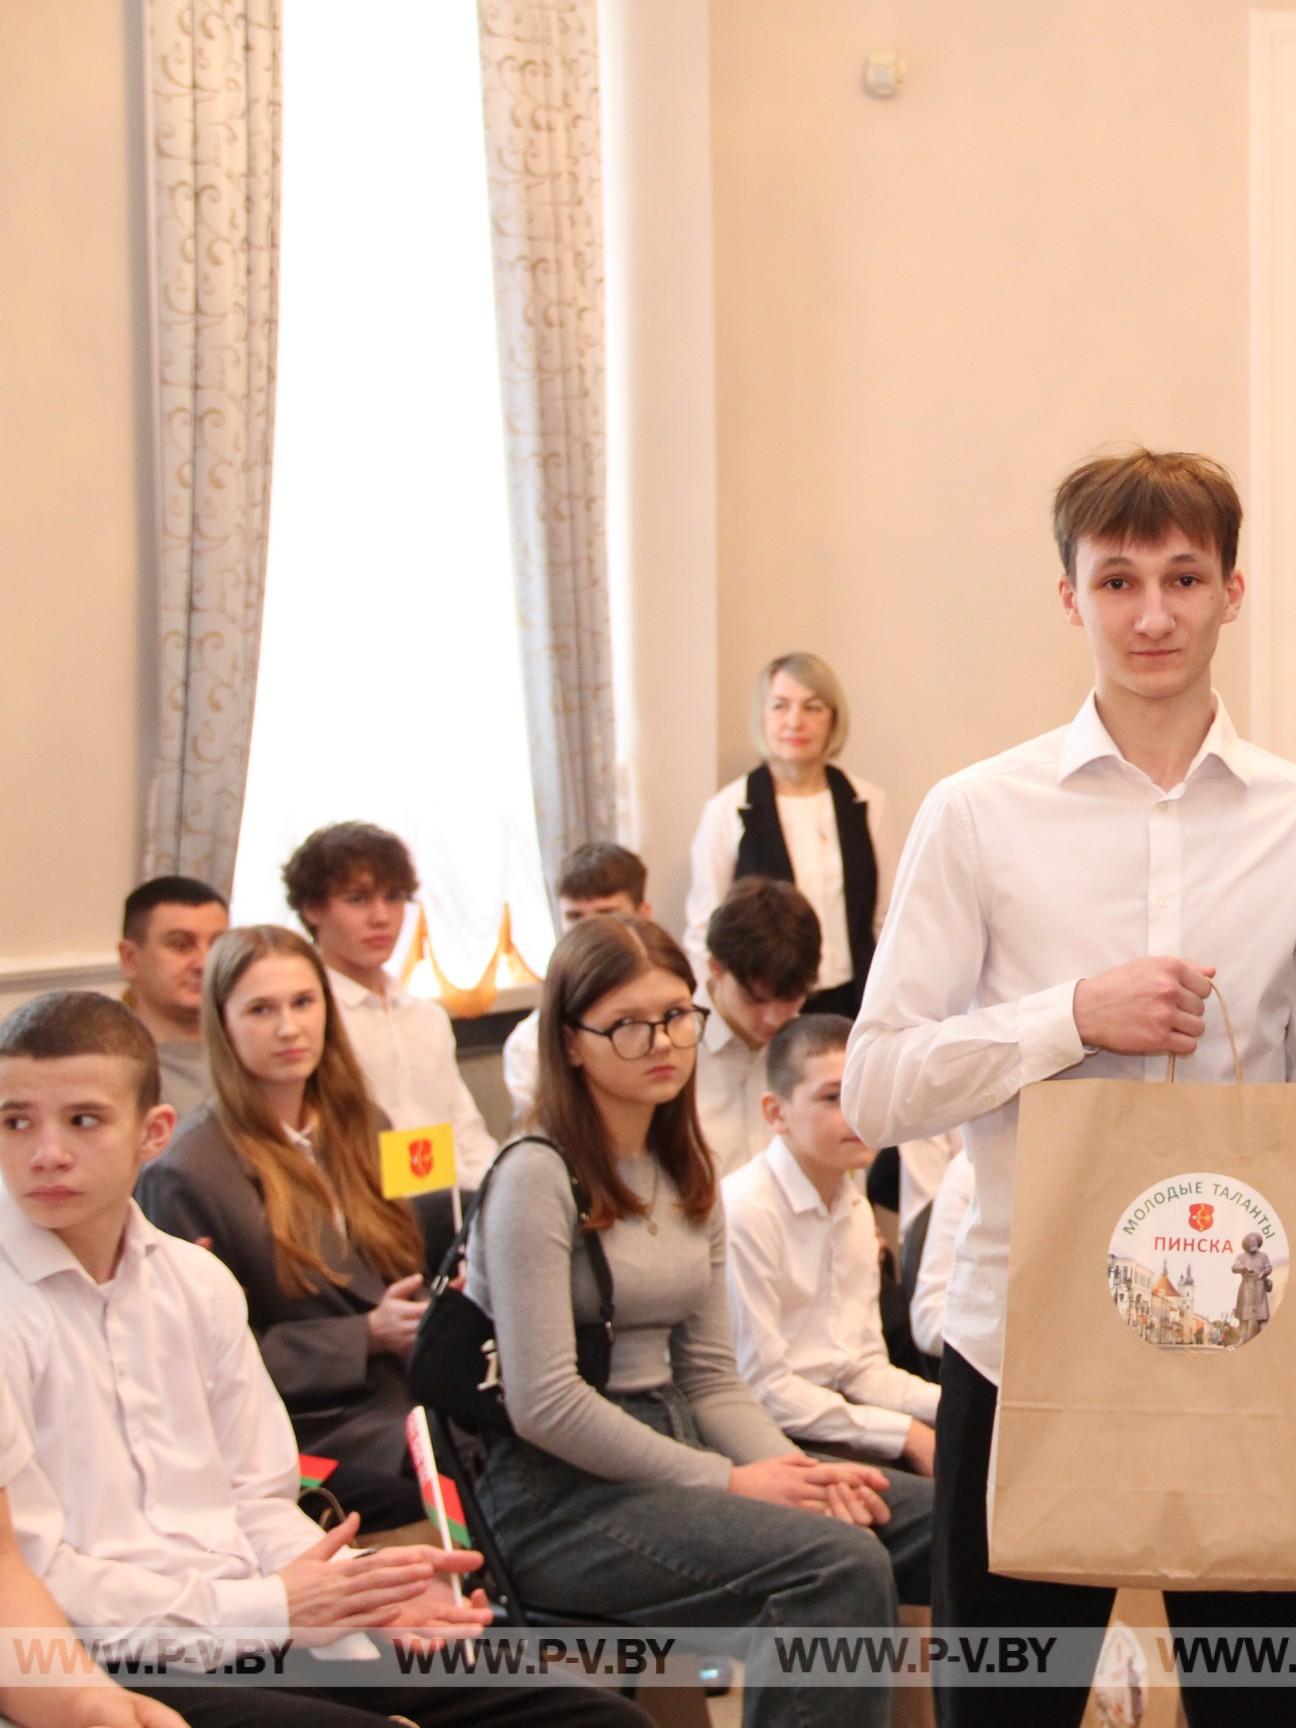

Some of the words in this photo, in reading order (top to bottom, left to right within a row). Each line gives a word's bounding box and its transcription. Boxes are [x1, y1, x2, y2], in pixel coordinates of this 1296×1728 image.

[1122, 1181, 1204, 1235] МОЛОДЫЕ
[1212, 1182, 1276, 1240] ТАЛАНТЫ
[1153, 1235, 1234, 1254] ПИНСКА
